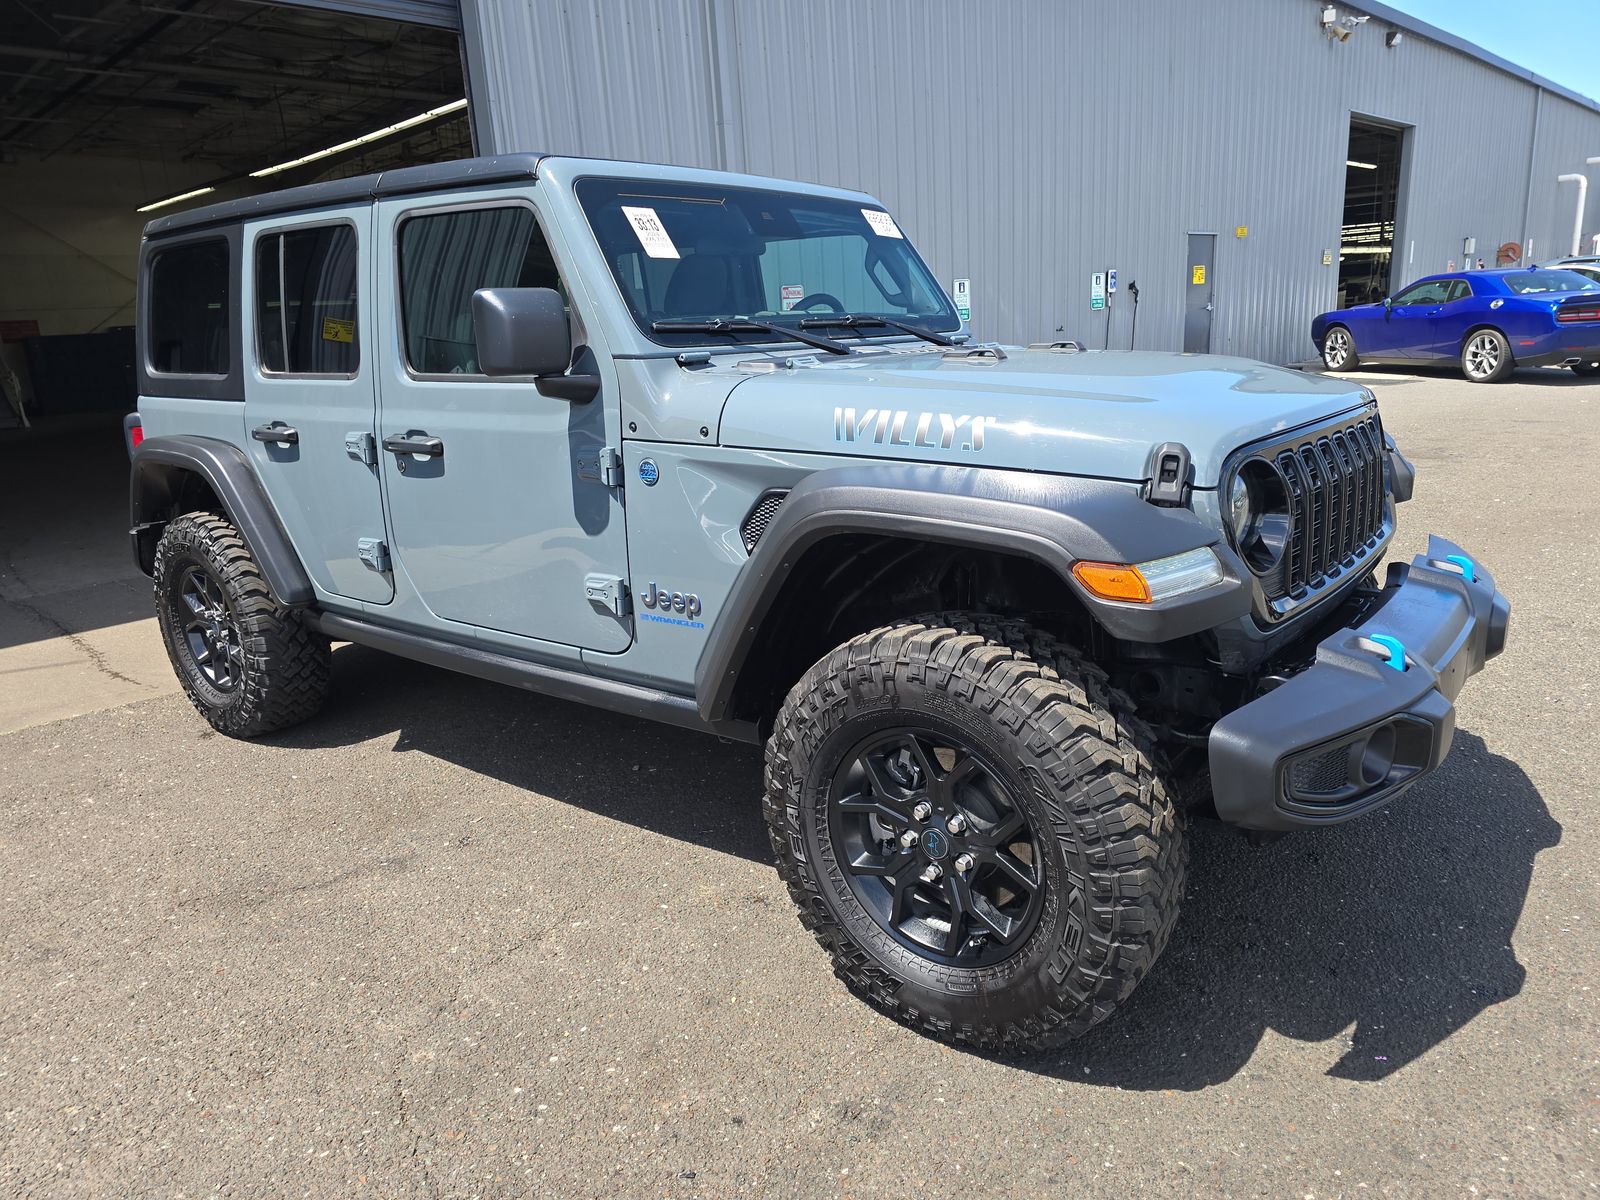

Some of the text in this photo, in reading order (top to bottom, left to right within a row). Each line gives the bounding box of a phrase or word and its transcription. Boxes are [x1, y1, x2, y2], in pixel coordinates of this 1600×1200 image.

[634, 217, 660, 232] 33:13
[834, 407, 996, 452] WILLYS
[640, 581, 702, 621] Jeep
[649, 614, 704, 630] WRANGLER
[1017, 764, 1086, 984] FALKEN
